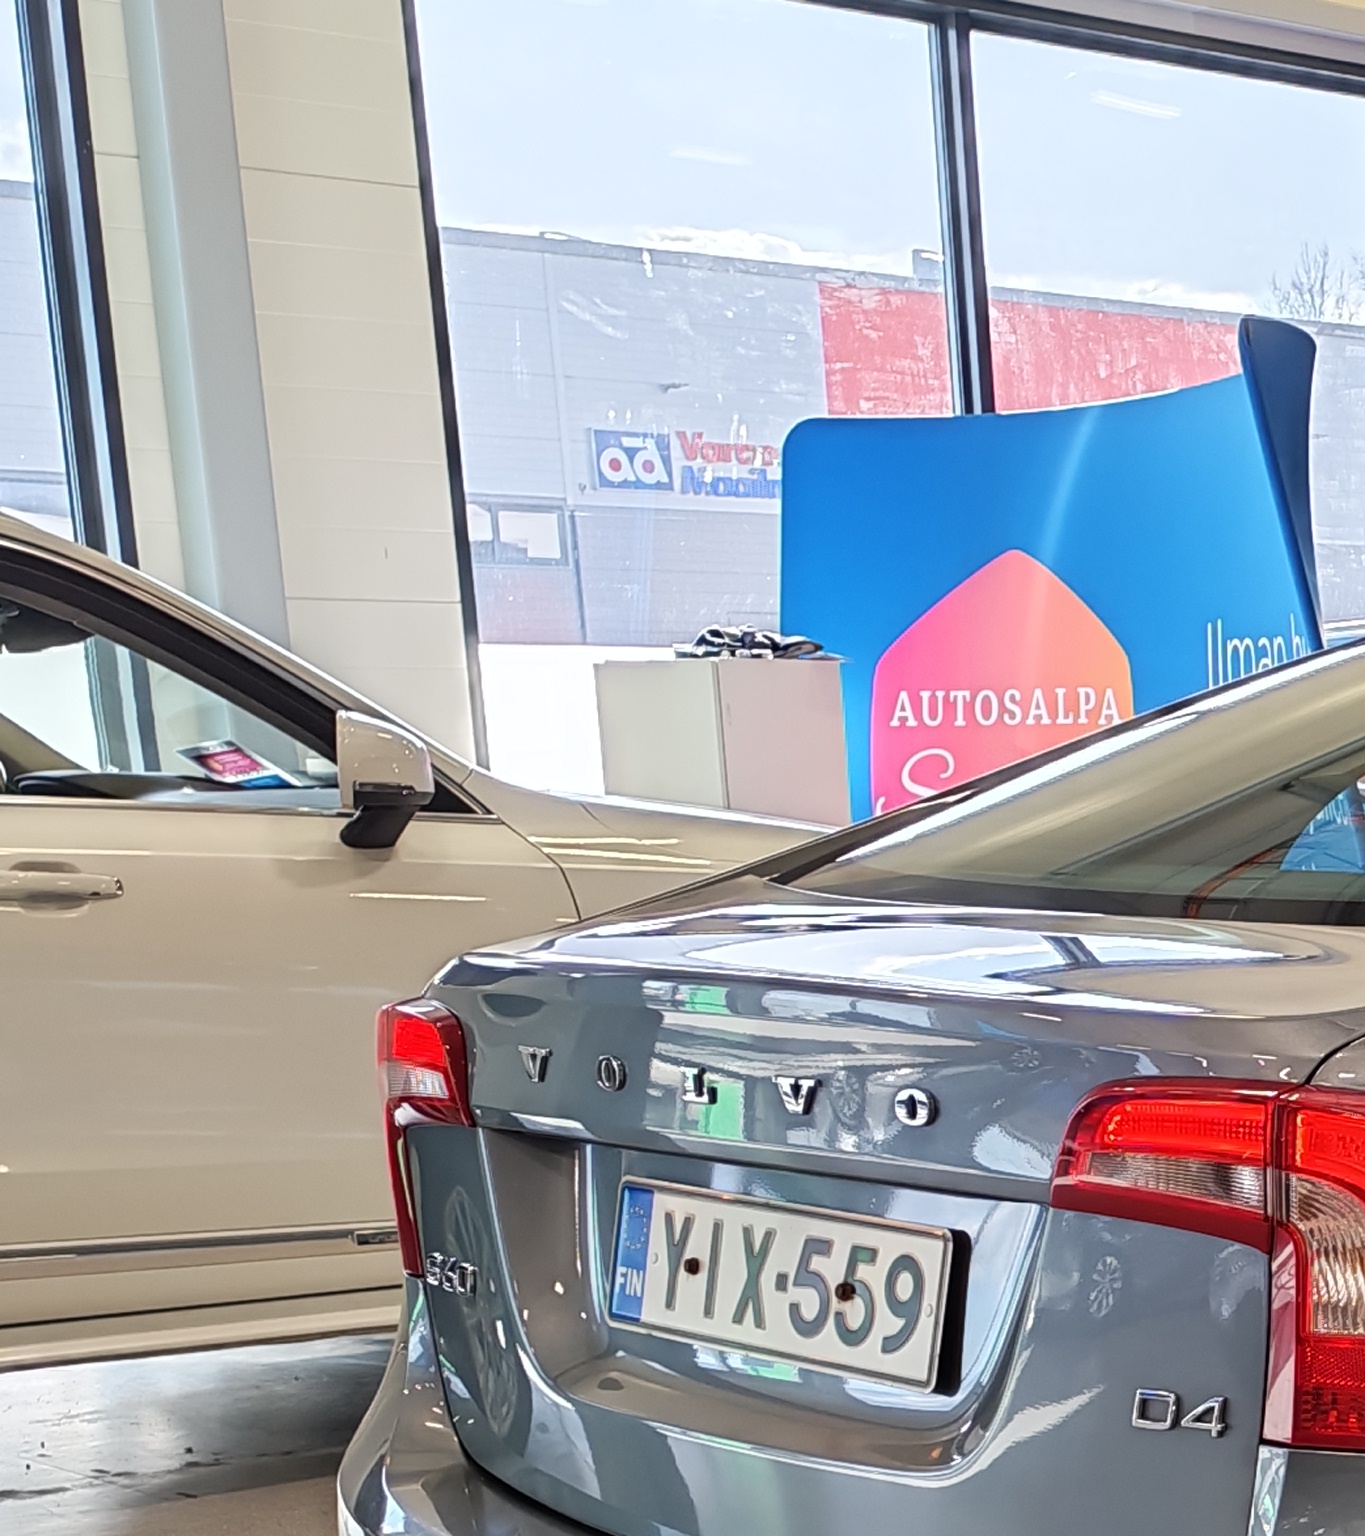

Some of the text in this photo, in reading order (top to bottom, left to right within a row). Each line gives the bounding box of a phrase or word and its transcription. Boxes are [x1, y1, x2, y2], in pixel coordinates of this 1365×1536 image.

[889, 687, 1122, 727] AUTOSALPA
[517, 1043, 938, 1128] VOLVO
[425, 1252, 479, 1298] S60
[615, 1265, 644, 1298] FIN
[664, 1209, 926, 1355] YIX-559
[1132, 1388, 1227, 1438] D4
